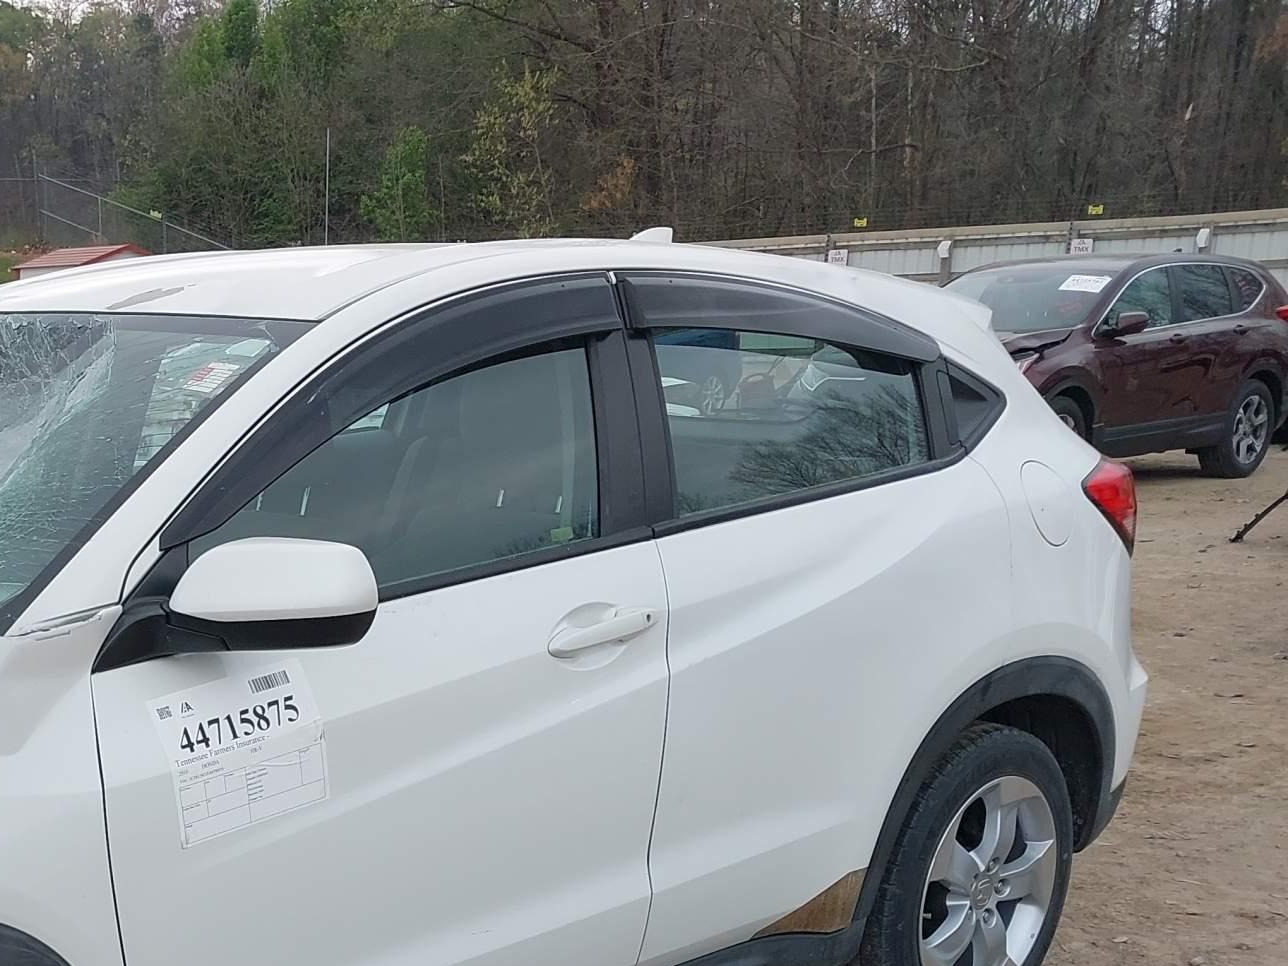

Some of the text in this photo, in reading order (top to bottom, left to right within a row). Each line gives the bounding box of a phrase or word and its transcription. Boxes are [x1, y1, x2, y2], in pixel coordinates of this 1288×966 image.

[179, 694, 300, 753] 44715875
[175, 752, 209, 768] Tennessee
[208, 744, 236, 758] Farmers
[235, 735, 266, 748] Insurance
